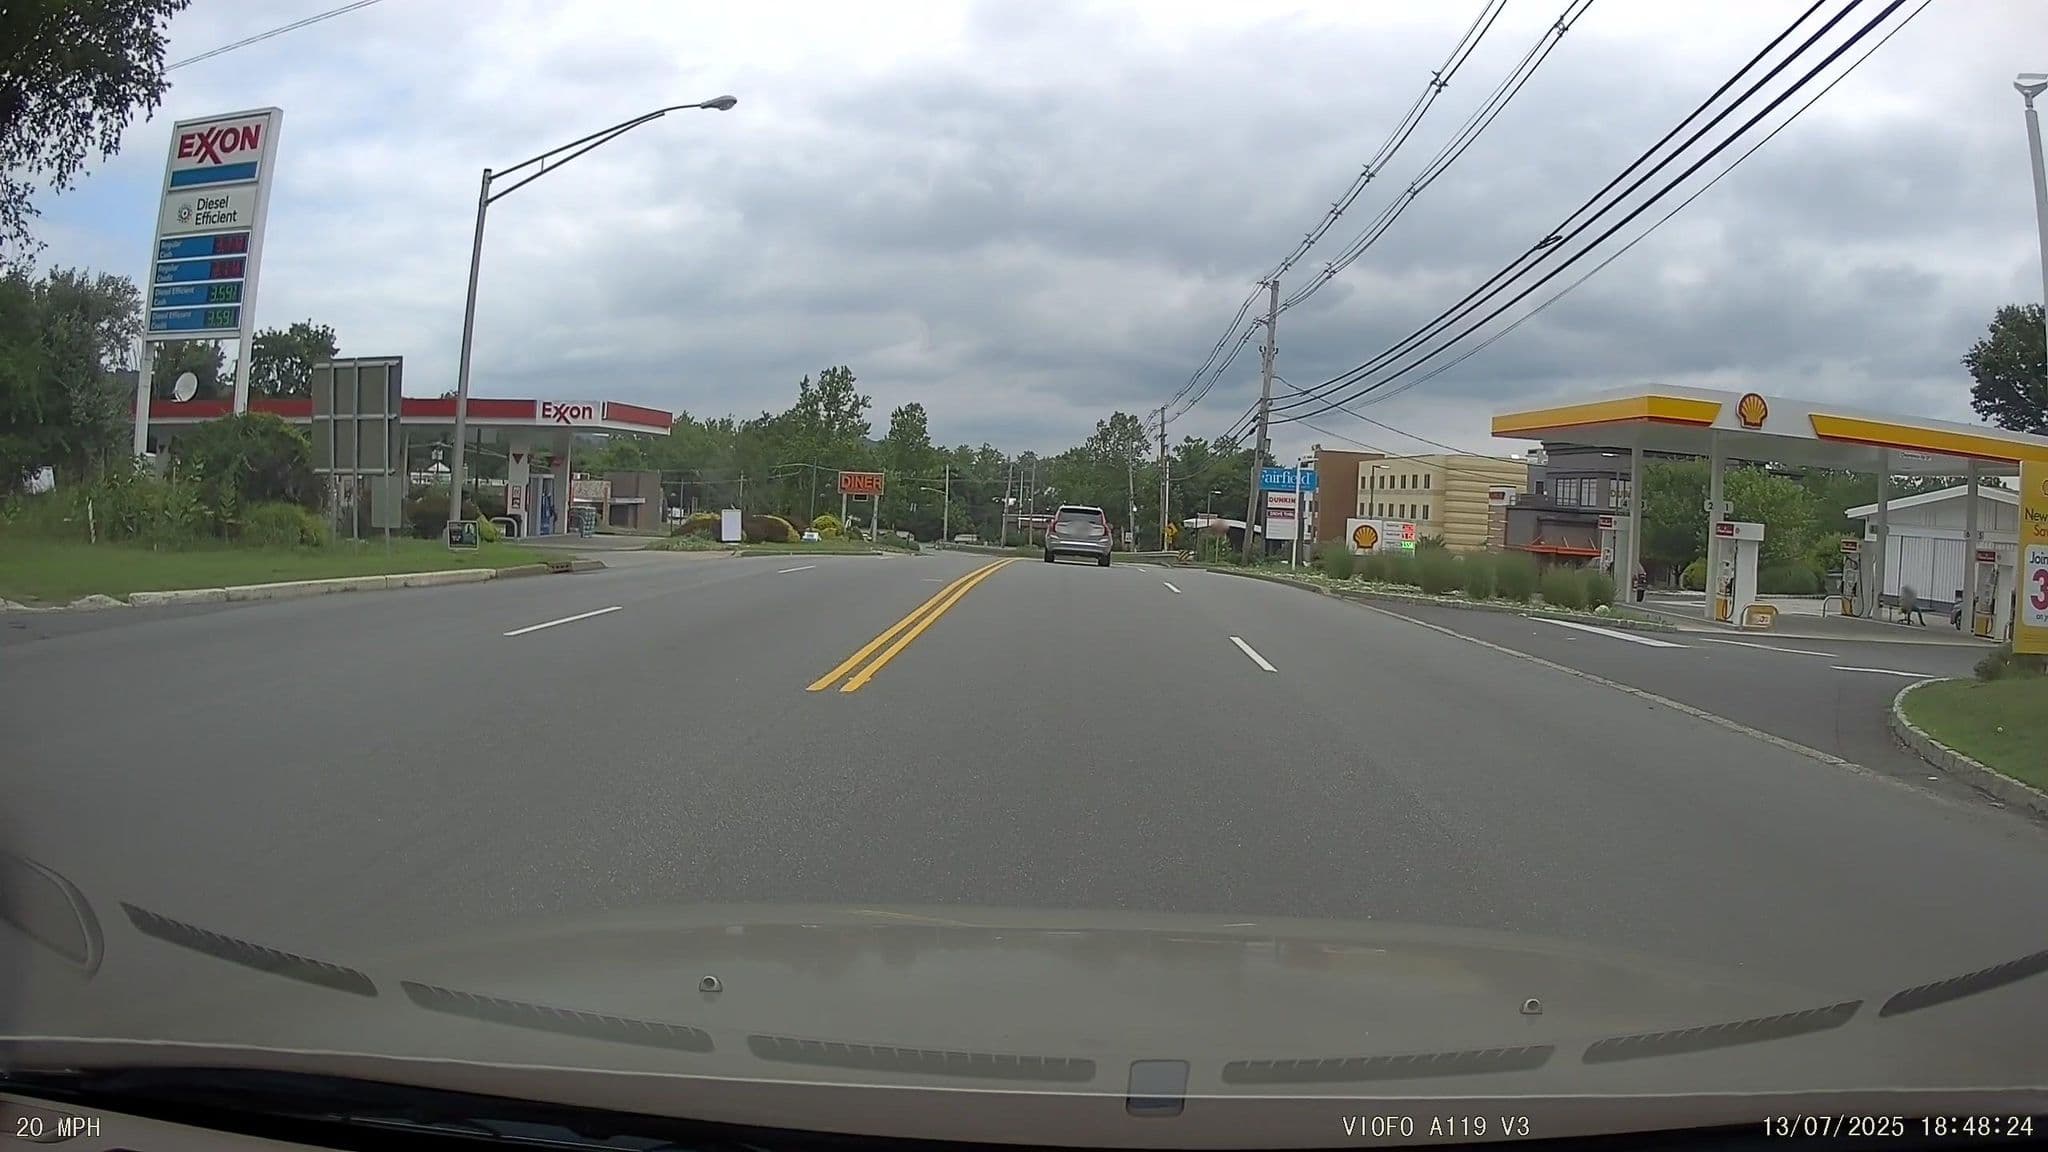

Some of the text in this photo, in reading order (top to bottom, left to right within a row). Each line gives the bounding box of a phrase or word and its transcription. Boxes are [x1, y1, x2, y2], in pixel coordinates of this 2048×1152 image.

[178, 124, 261, 164] EXXON
[197, 195, 230, 211] Diesel
[195, 210, 238, 226] Efficient
[542, 401, 593, 425] Exxon
[841, 474, 881, 489] DINER
[1262, 469, 1310, 484] airfied
